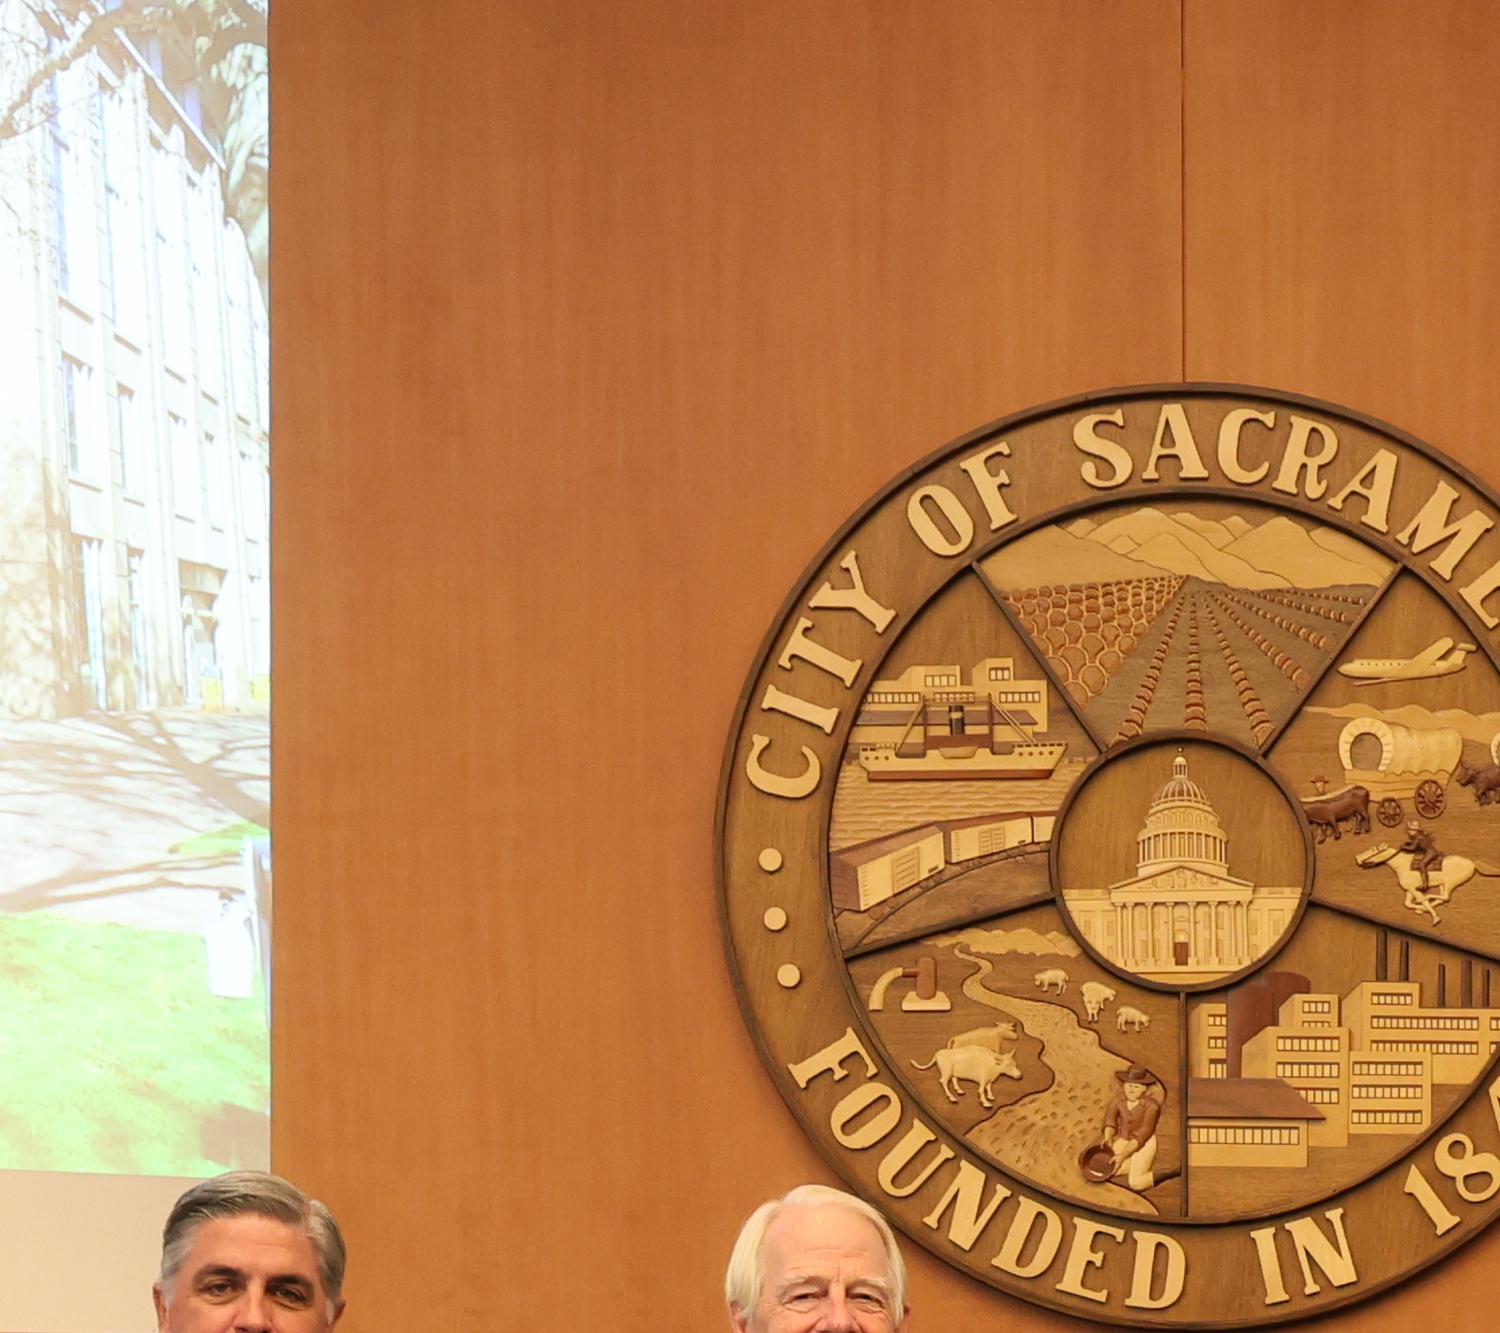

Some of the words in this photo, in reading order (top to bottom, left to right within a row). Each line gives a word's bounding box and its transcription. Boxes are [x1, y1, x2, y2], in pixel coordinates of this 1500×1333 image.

[745, 551, 897, 800] CITY
[905, 440, 1020, 558] OF
[787, 1026, 1187, 1311] FOUNDED
[1250, 1207, 1360, 1306] IN
